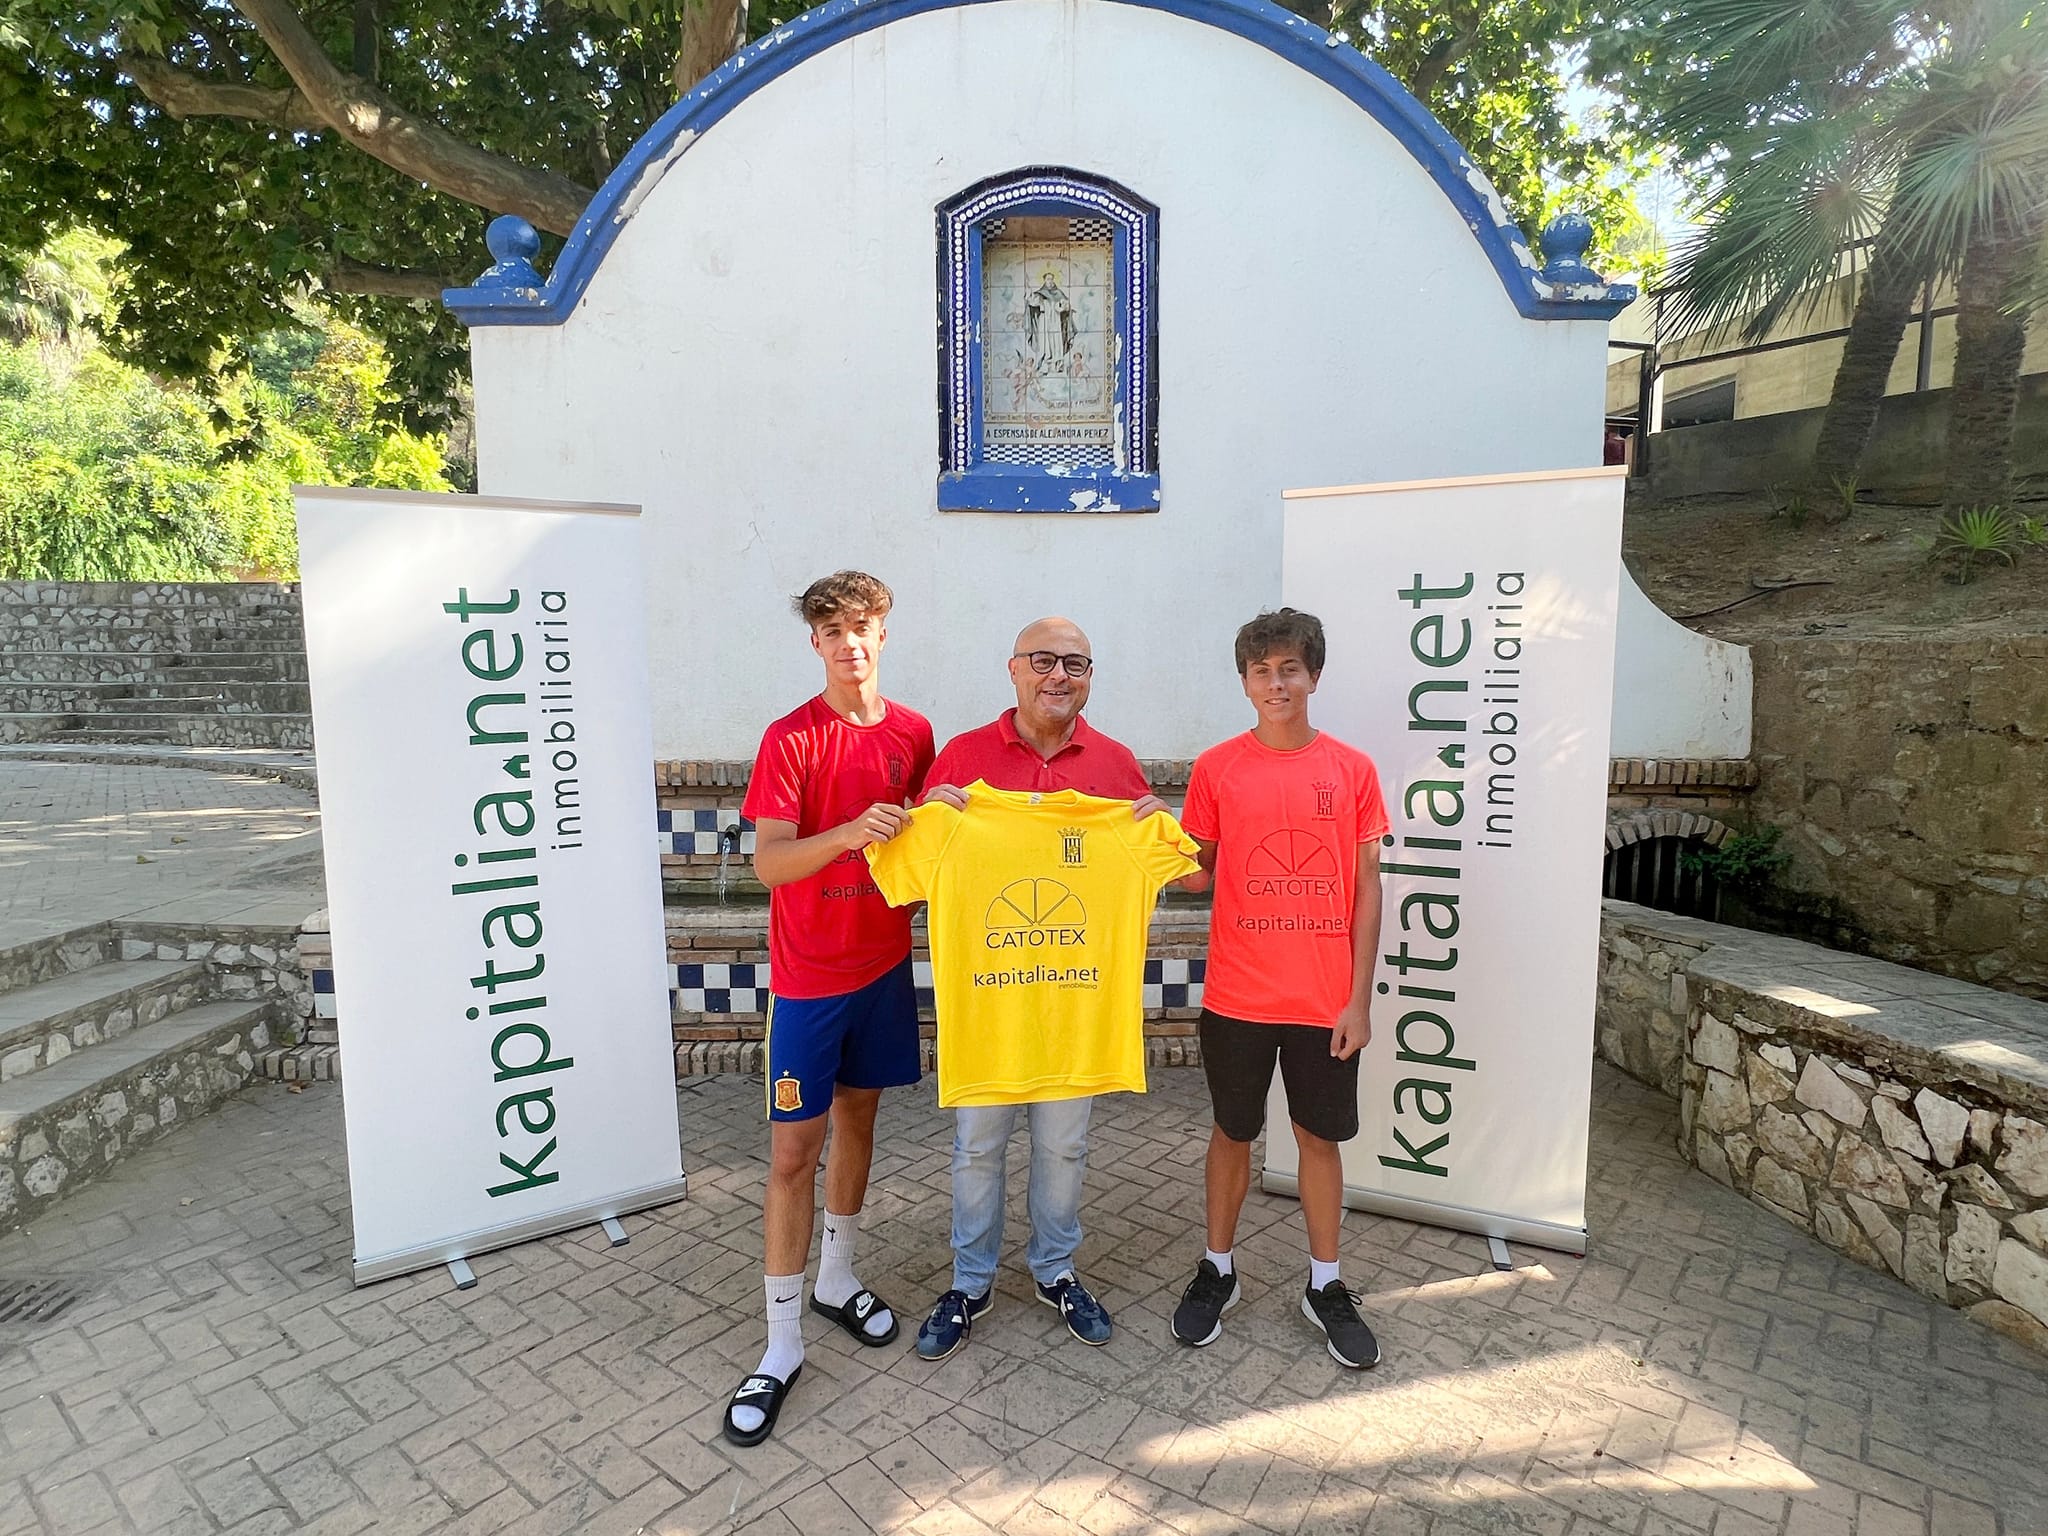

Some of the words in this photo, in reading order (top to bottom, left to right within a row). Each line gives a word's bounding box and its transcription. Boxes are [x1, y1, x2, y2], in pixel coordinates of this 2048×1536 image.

[985, 429, 991, 438] A
[993, 428, 1029, 438] ESPENSAS
[1084, 428, 1109, 438] PEREZ
[540, 589, 583, 850] inmobiliaria
[1477, 571, 1525, 849] inmobiliaria
[442, 586, 574, 1198] kapitalia.net
[1246, 879, 1338, 897] CATOTEX
[985, 928, 1086, 949] CATOTEX
[973, 964, 1099, 989] kapitalia.net
